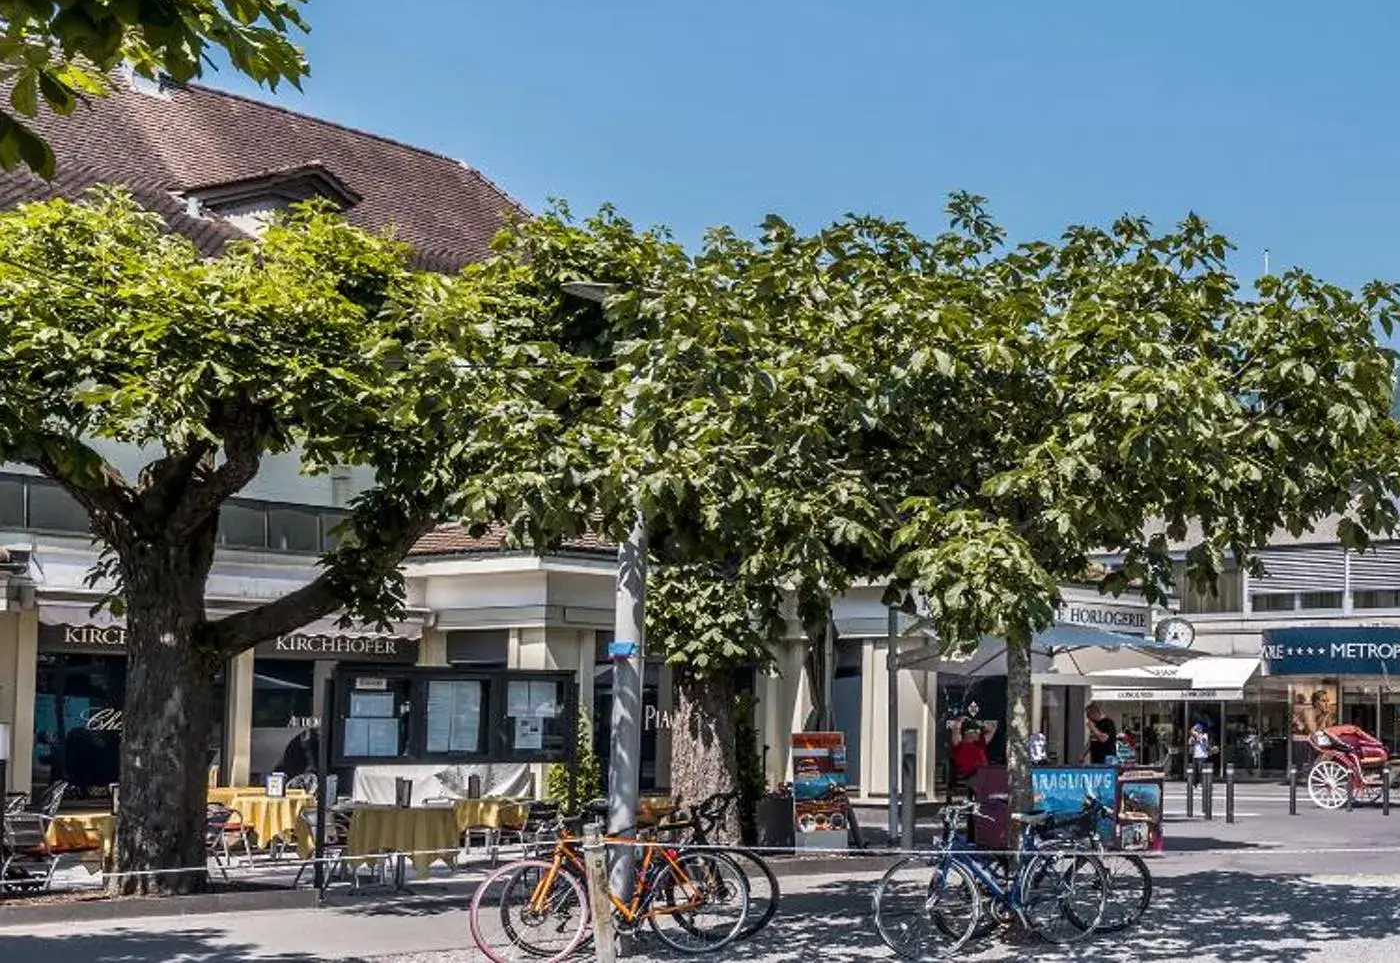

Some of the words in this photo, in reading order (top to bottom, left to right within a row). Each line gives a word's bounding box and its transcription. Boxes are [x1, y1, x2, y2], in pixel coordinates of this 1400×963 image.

[1071, 607, 1147, 627] HORLOGERIE
[276, 636, 397, 654] KIRCHHOFER
[645, 705, 673, 731] PIA
